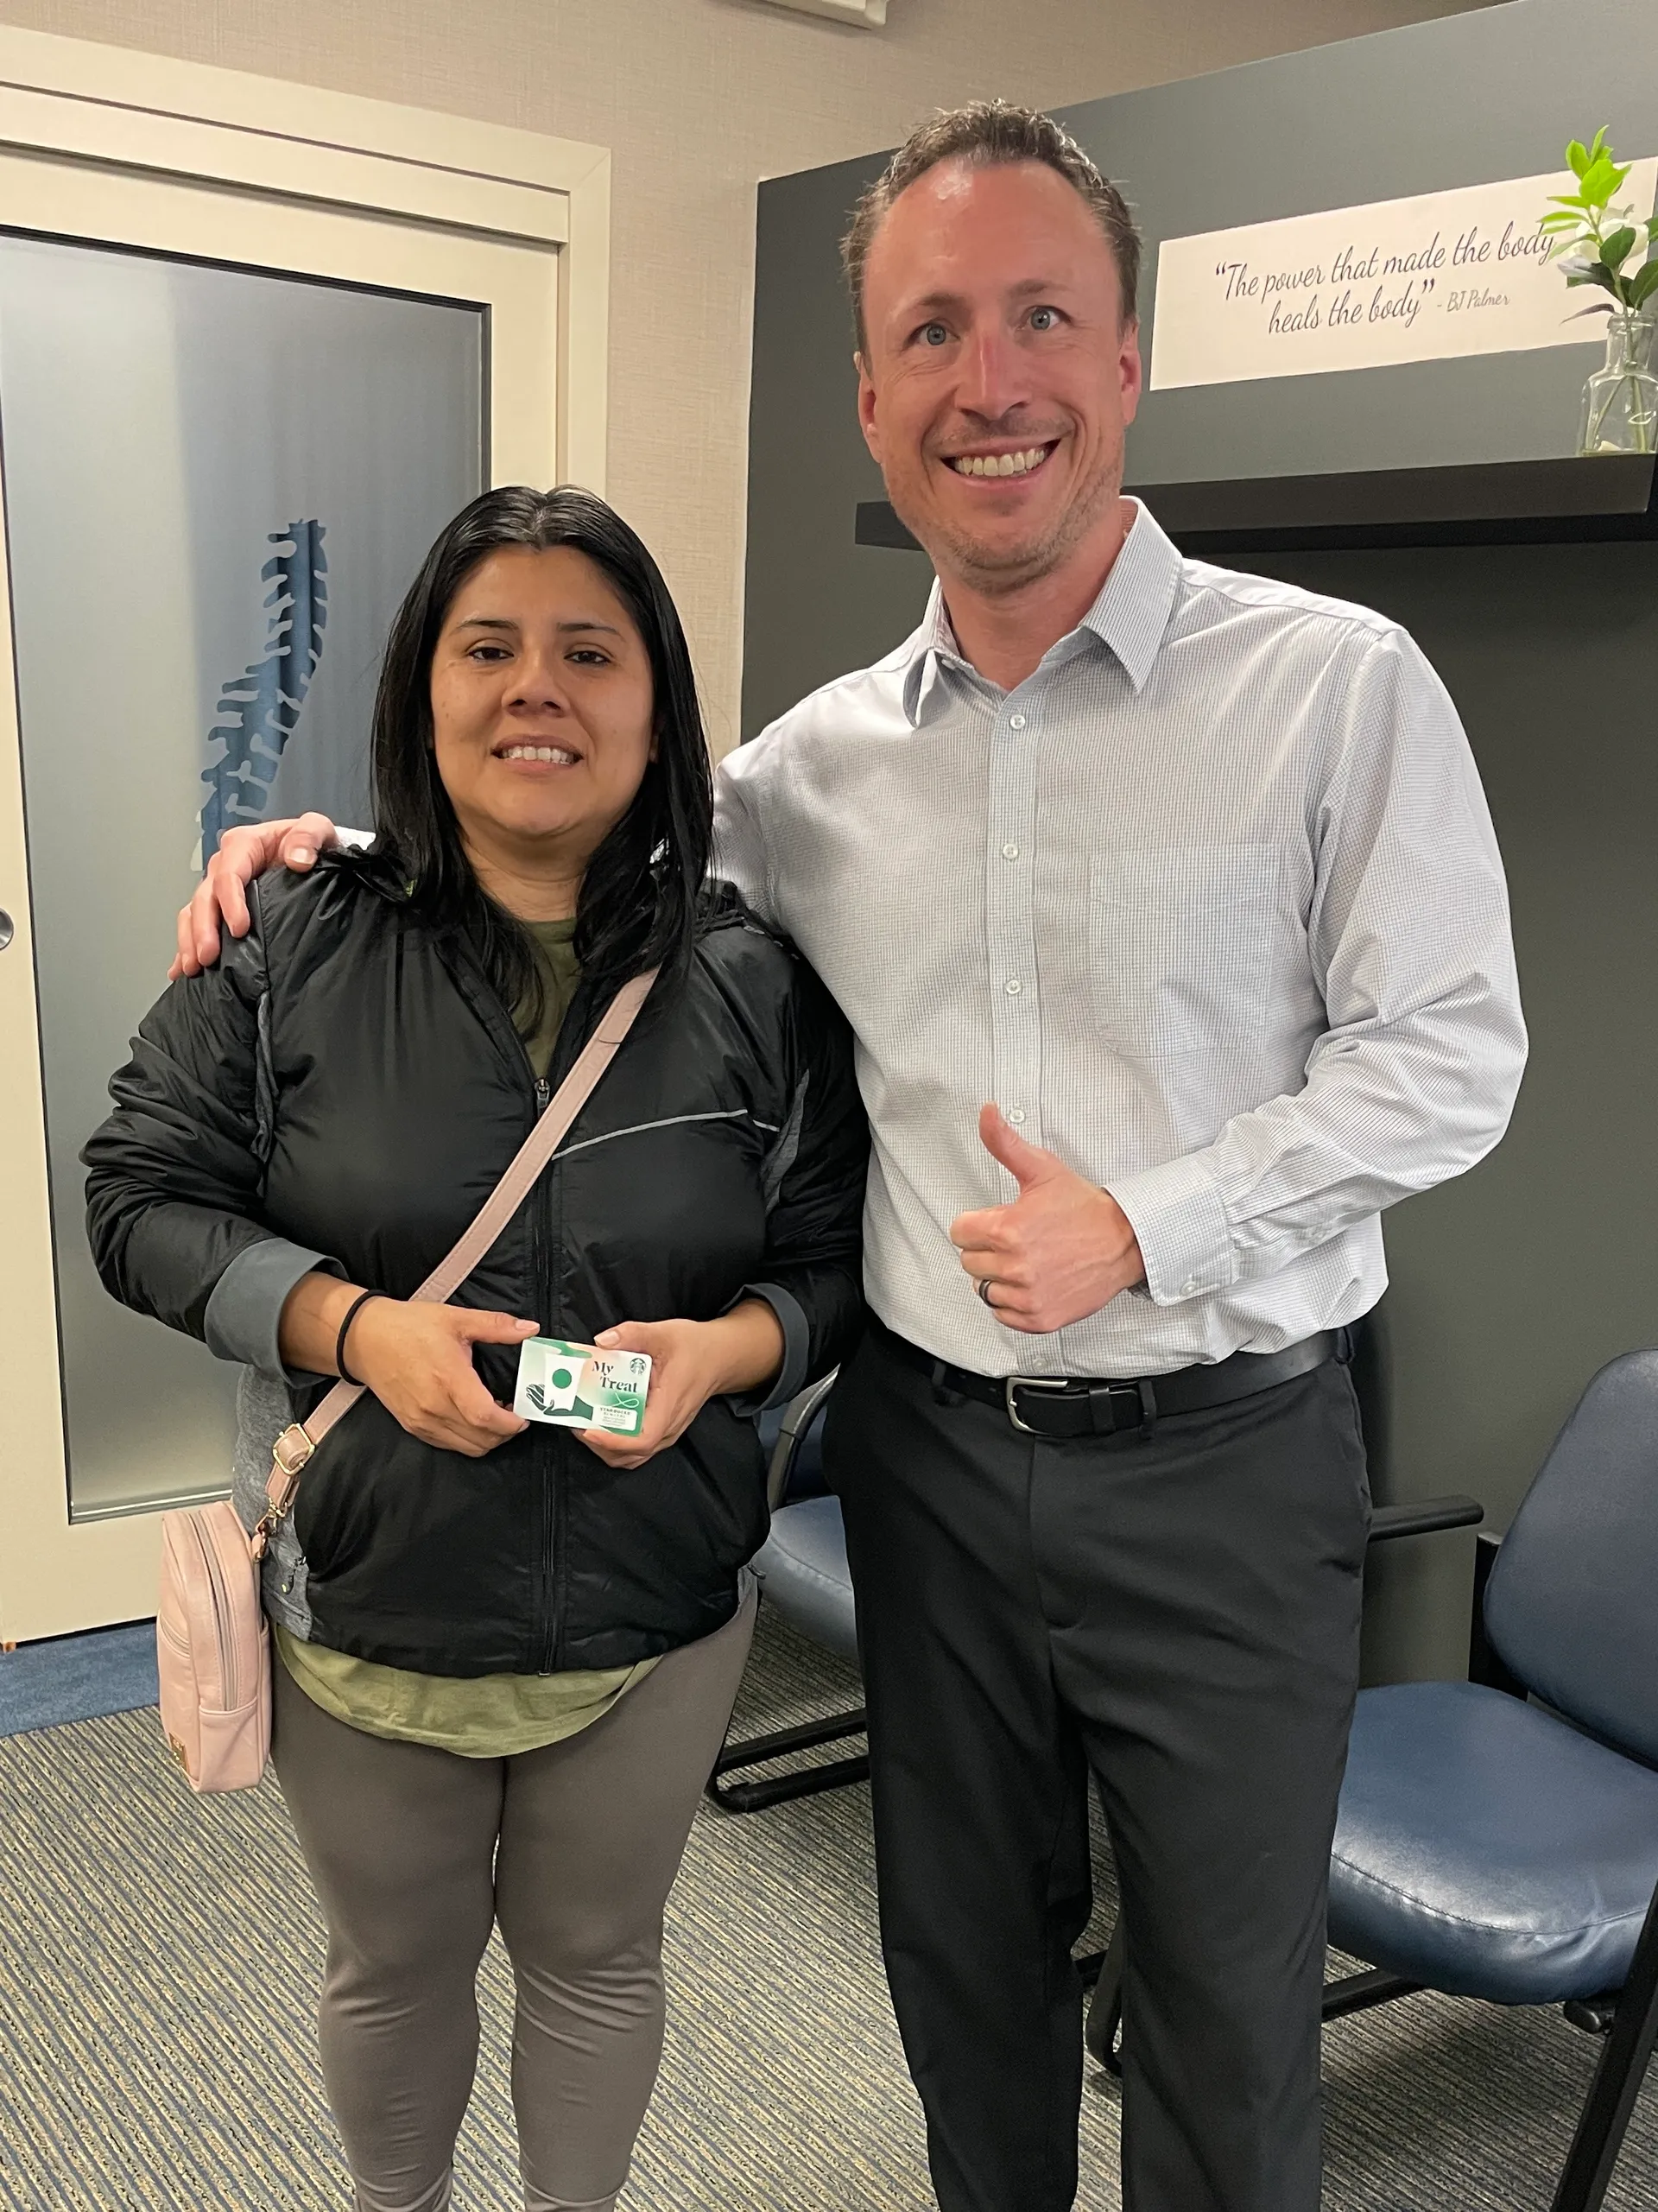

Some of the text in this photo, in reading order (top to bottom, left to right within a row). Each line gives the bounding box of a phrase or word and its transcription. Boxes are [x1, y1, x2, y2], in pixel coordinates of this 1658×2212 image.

[1261, 264, 1326, 304] power
[1332, 245, 1379, 283] that
[1383, 231, 1446, 276] made
[1452, 226, 1490, 266] the
[1498, 221, 1557, 266] body
[1269, 294, 1322, 334] heals
[1328, 289, 1363, 326] the
[1447, 290, 1467, 312] BJ
[1466, 287, 1510, 309] Palmer
[592, 1361, 614, 1376] My
[600, 1377, 638, 1393] Treat
